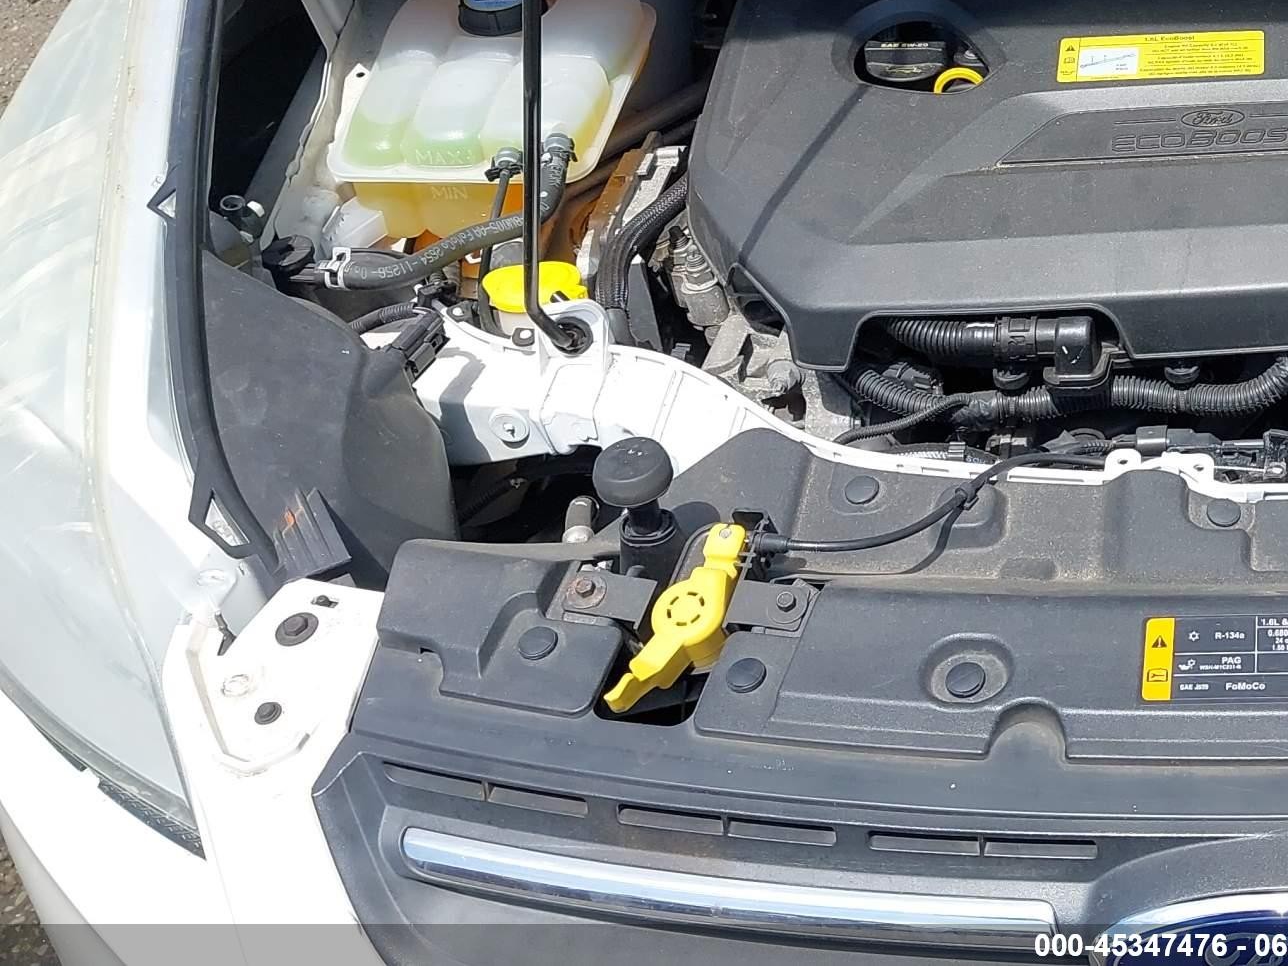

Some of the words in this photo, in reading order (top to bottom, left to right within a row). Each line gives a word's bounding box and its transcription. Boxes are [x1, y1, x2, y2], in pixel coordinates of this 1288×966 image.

[431, 185, 468, 200] MIN
[1261, 618, 1279, 626] 1.6L
[1214, 631, 1245, 640] R-134a
[1221, 656, 1242, 664] PAG
[1225, 682, 1266, 691] FoMoCo
